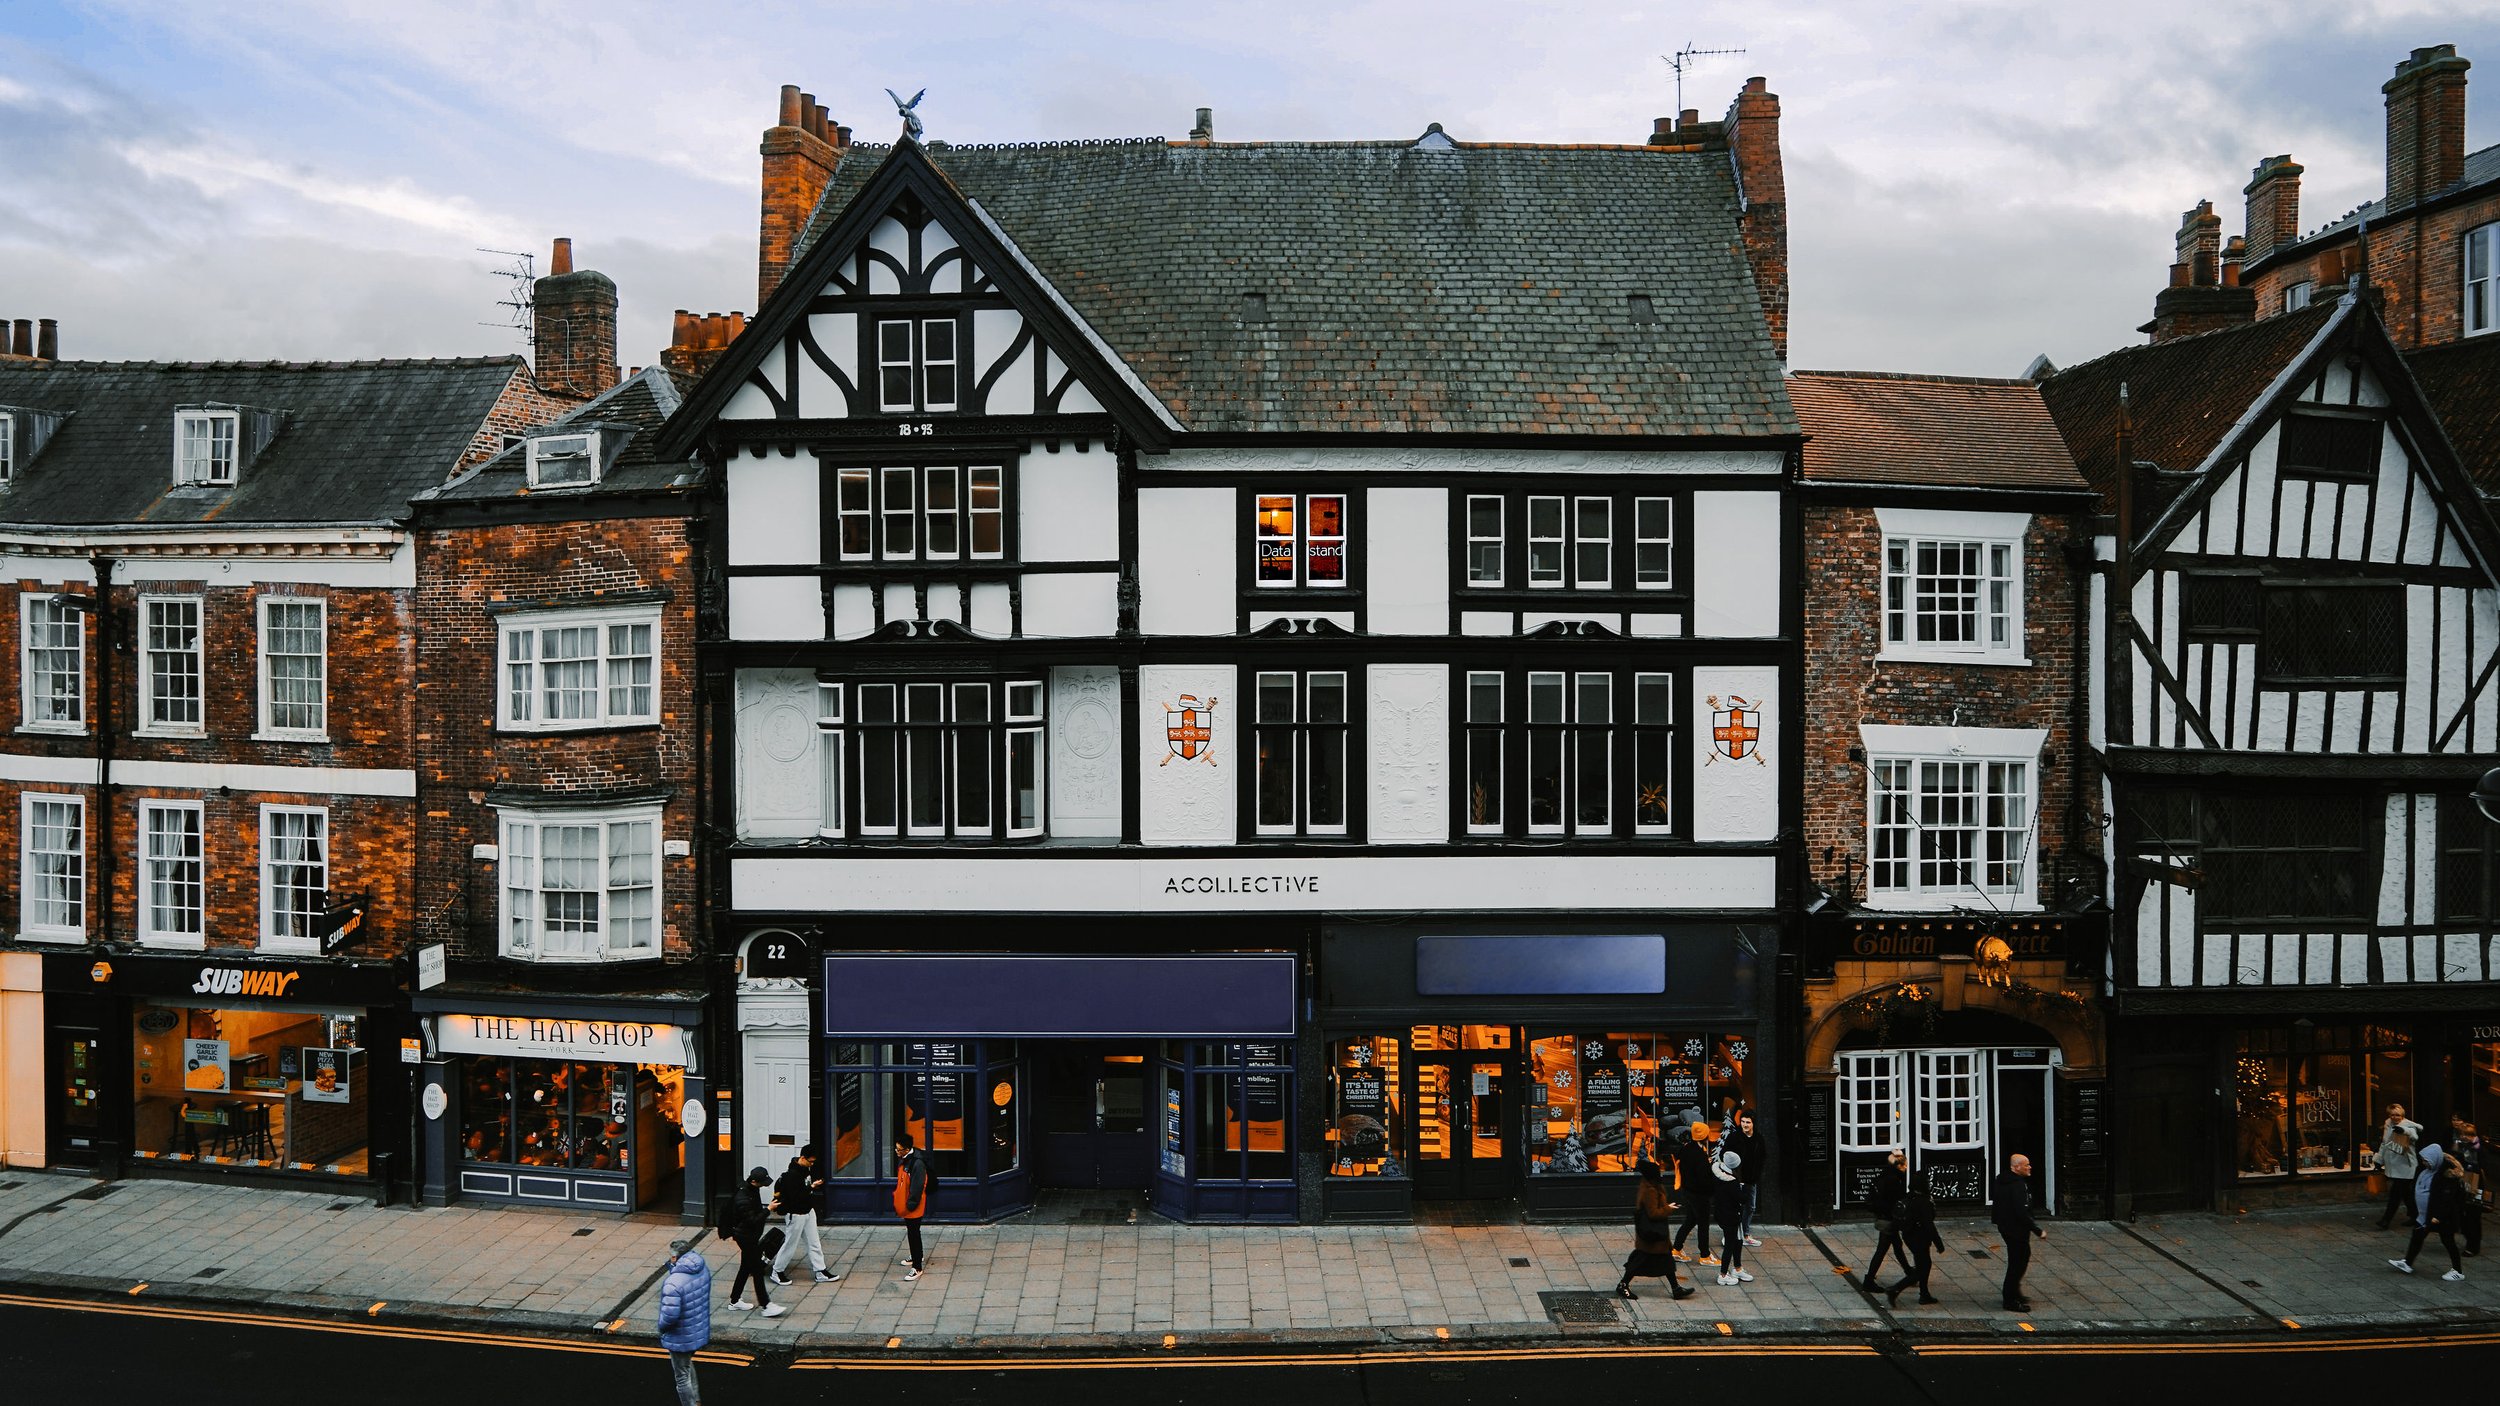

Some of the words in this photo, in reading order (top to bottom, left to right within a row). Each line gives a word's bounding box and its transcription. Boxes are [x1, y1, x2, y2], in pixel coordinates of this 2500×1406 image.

[1262, 544, 1291, 556] Data
[1309, 545, 1342, 556] stand
[1165, 876, 1318, 893] ACOLLECTIVE
[326, 912, 364, 948] SUBWAY
[1852, 931, 1936, 955] Golden
[426, 950, 436, 961] THE
[768, 944, 786, 959] 22
[192, 968, 300, 996] SUBWAY
[471, 1015, 518, 1040] THE
[530, 1020, 578, 1044] HAT
[589, 1022, 653, 1046] SHOP
[2306, 1100, 2338, 1111] YORK
[2307, 1110, 2336, 1122] GIN
[133, 1150, 160, 1159] SUBWAY
[168, 1152, 195, 1161] SUBWAY
[246, 1158, 273, 1167] SUBWAY
[288, 1161, 316, 1171] SUBWAY
[325, 1165, 354, 1175] SUBWAY
